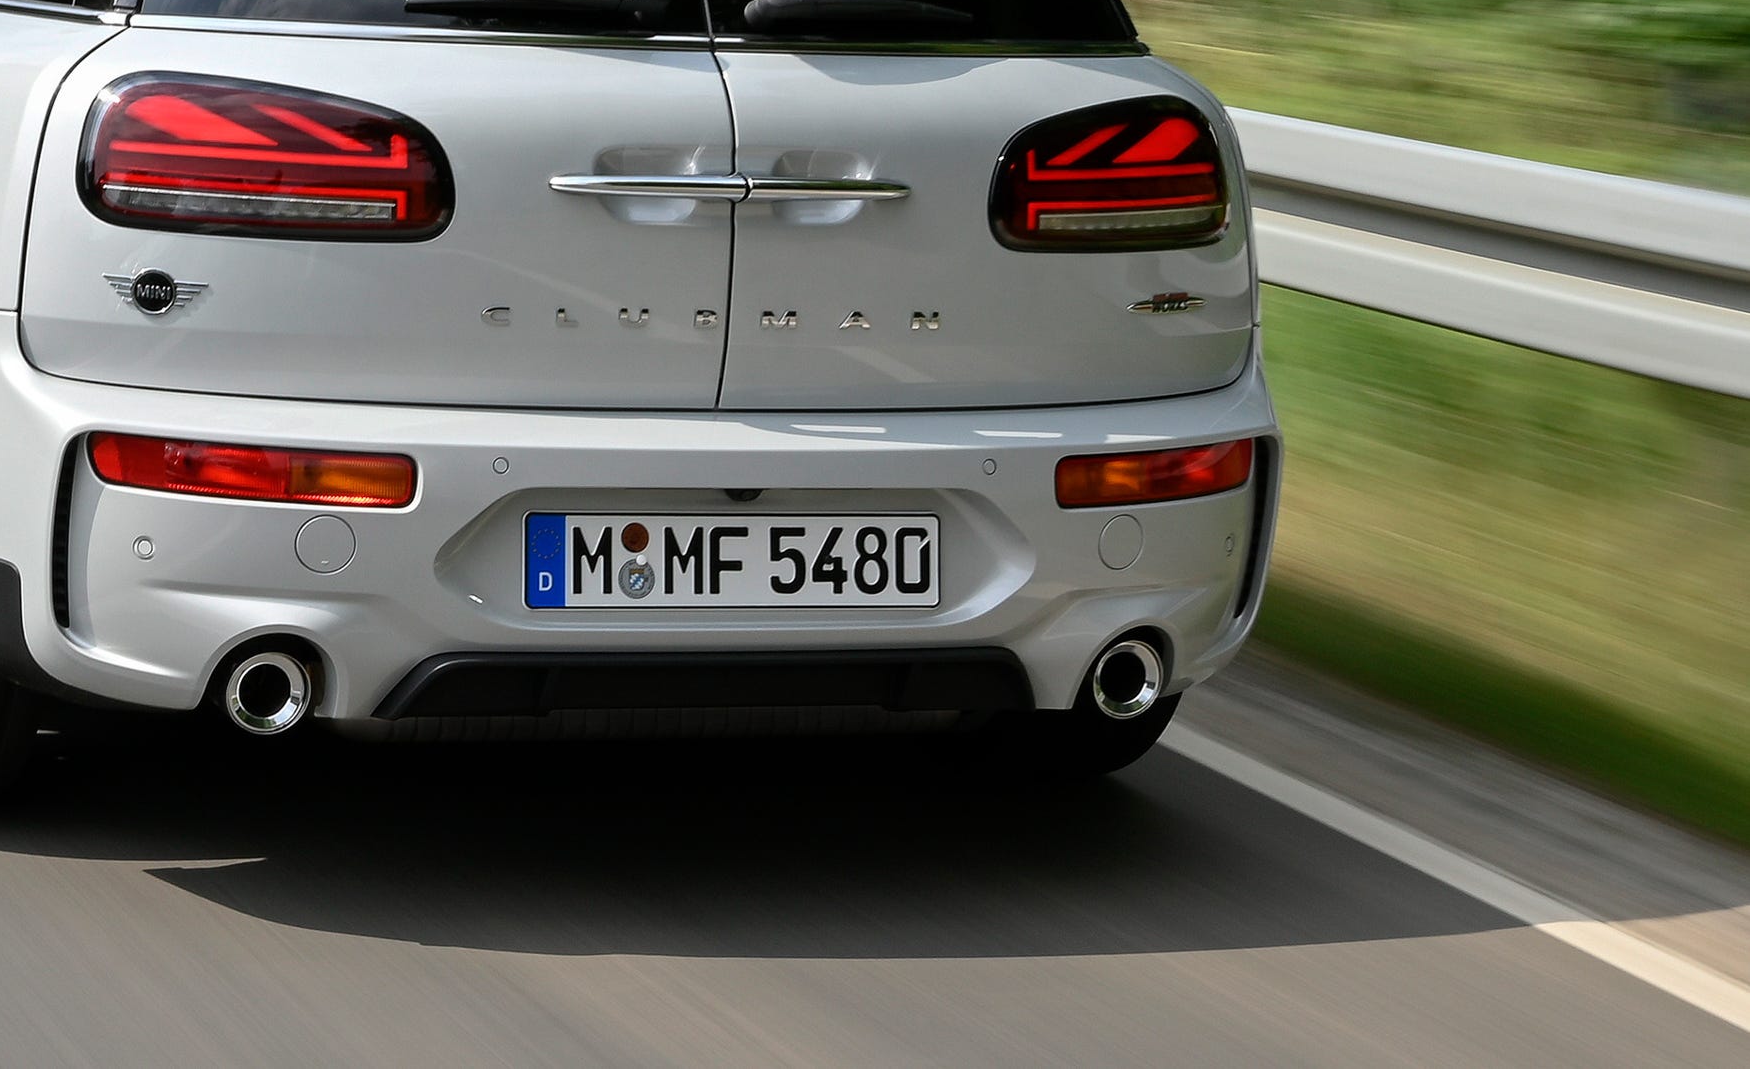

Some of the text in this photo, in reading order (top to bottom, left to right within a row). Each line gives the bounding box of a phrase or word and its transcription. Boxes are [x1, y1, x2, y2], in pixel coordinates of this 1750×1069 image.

[136, 283, 171, 300] MINI
[480, 305, 941, 330] CLUBMAN
[572, 526, 612, 595] M
[664, 526, 748, 595] MF
[769, 526, 931, 595] 5480
[538, 571, 553, 591] D
